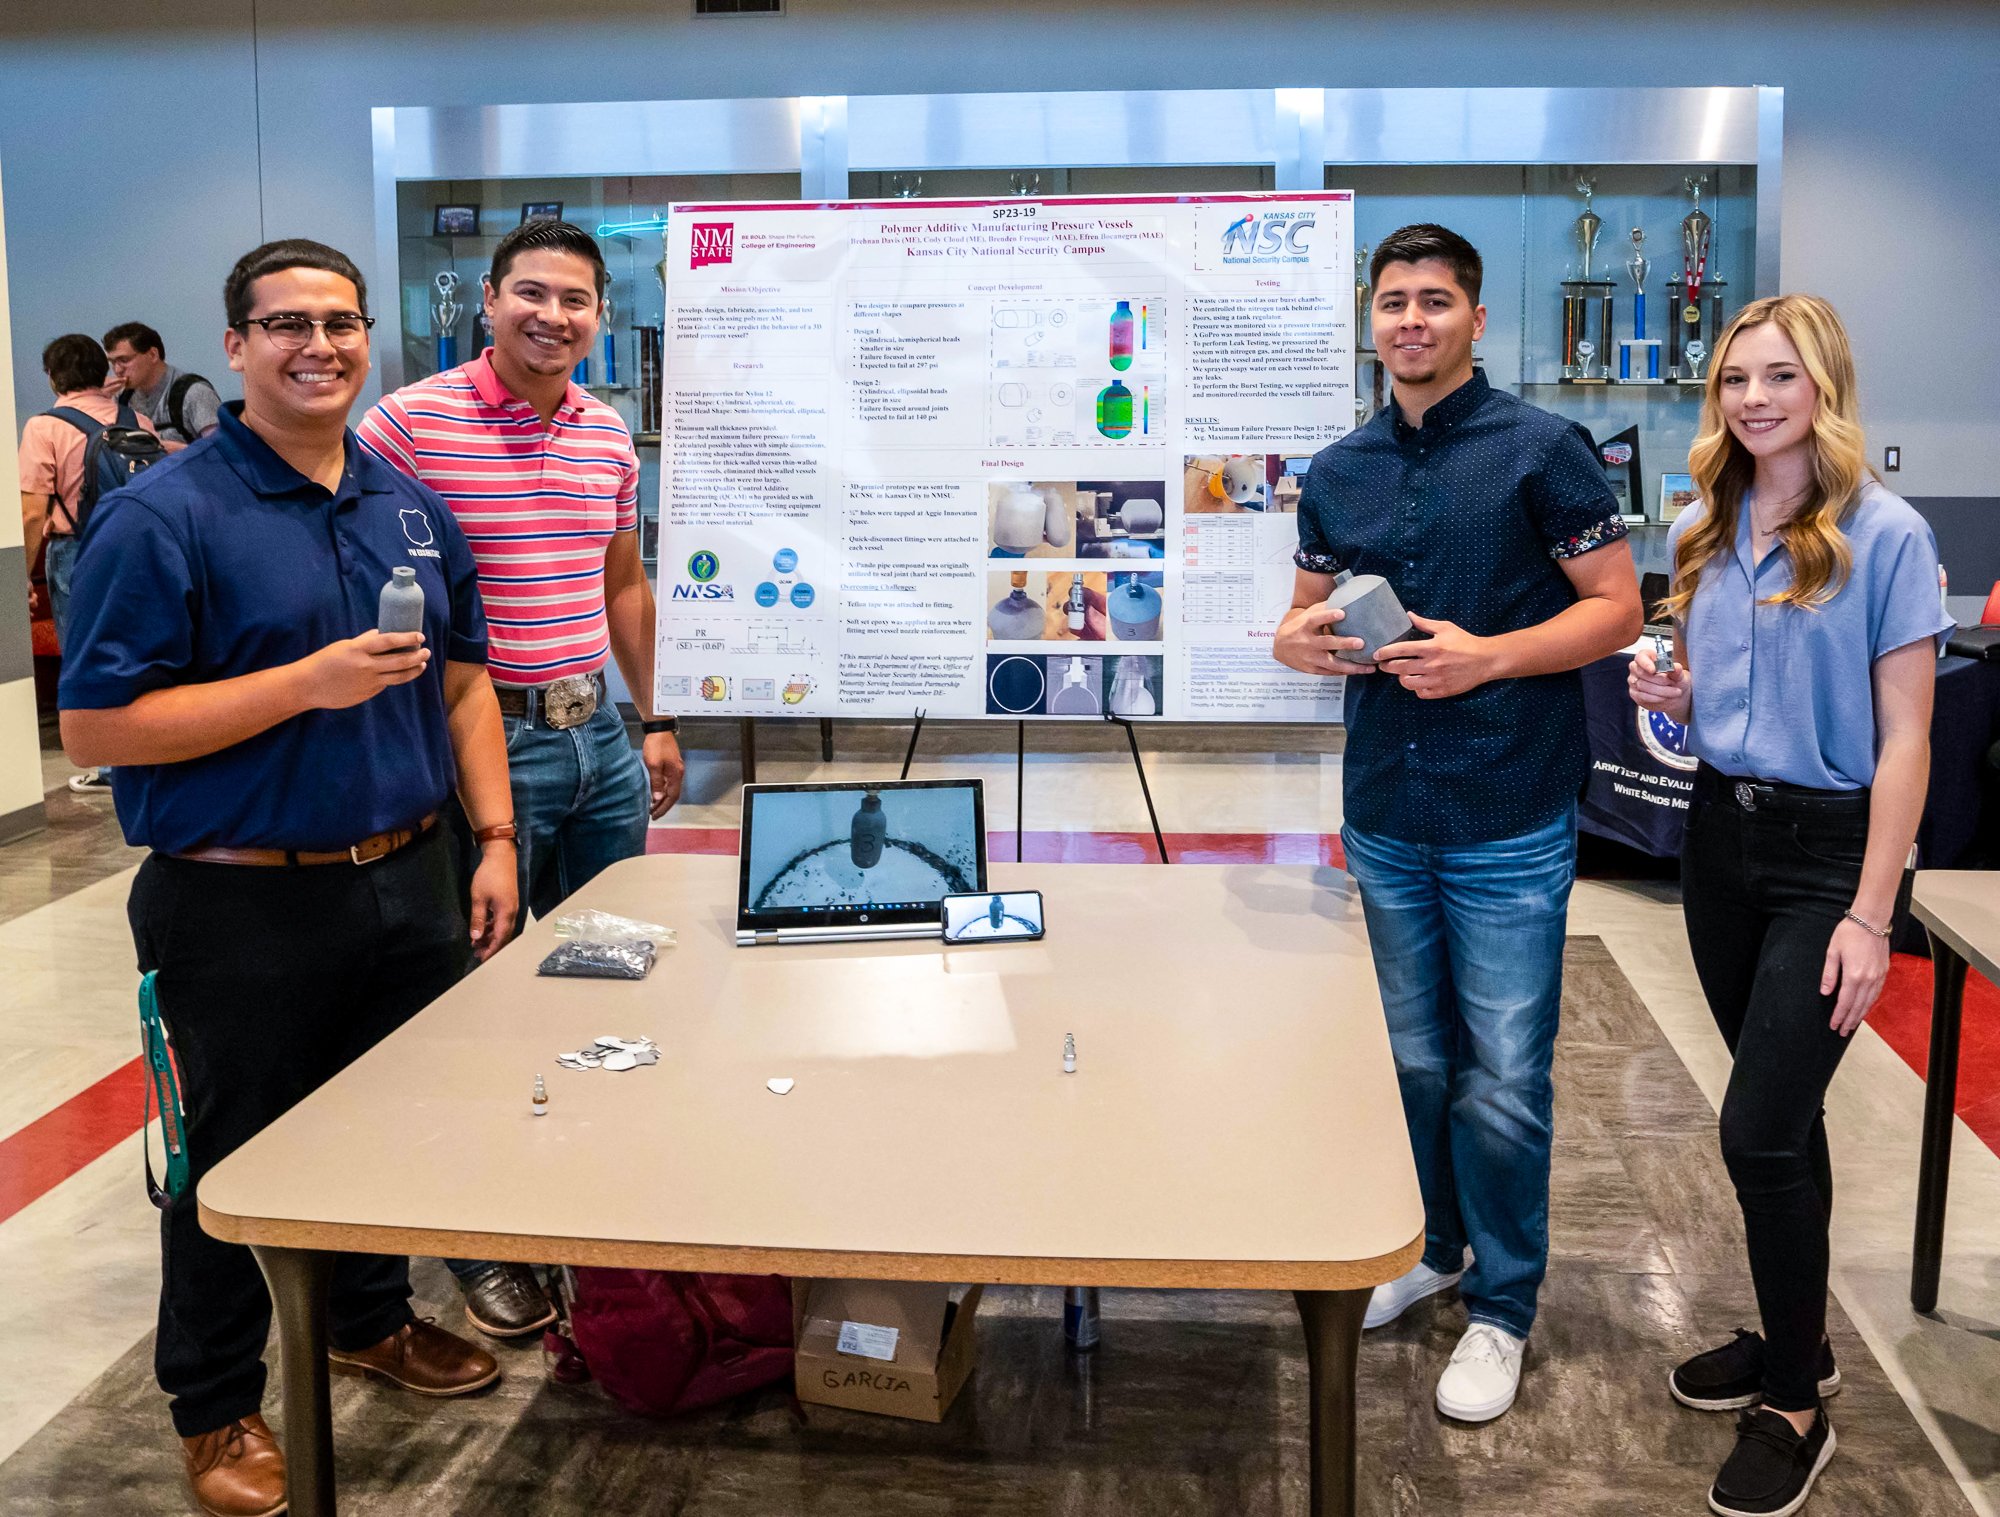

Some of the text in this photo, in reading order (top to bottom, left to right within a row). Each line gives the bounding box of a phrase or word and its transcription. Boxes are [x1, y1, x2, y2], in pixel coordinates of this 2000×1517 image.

[993, 207, 1035, 219] SP23-19
[881, 220, 1132, 235] Polymer Additive Manufacturing Pressure Vessels
[692, 228, 732, 247] NM
[924, 236, 940, 244] Cody
[1222, 220, 1316, 254] NSC
[692, 248, 732, 258] STATE
[908, 245, 1105, 257] Kansas City National Security Campus
[968, 283, 1042, 291] Concept Development
[1001, 460, 1024, 468] Design
[1127, 628, 1136, 637] 3
[1593, 760, 1620, 774] ARMY
[1640, 774, 1658, 784] AND
[1660, 776, 1693, 791] EVALU
[1614, 783, 1690, 809] WHITE SANDS MIS
[860, 834, 874, 853] 3
[823, 1370, 911, 1391] GARCIA
